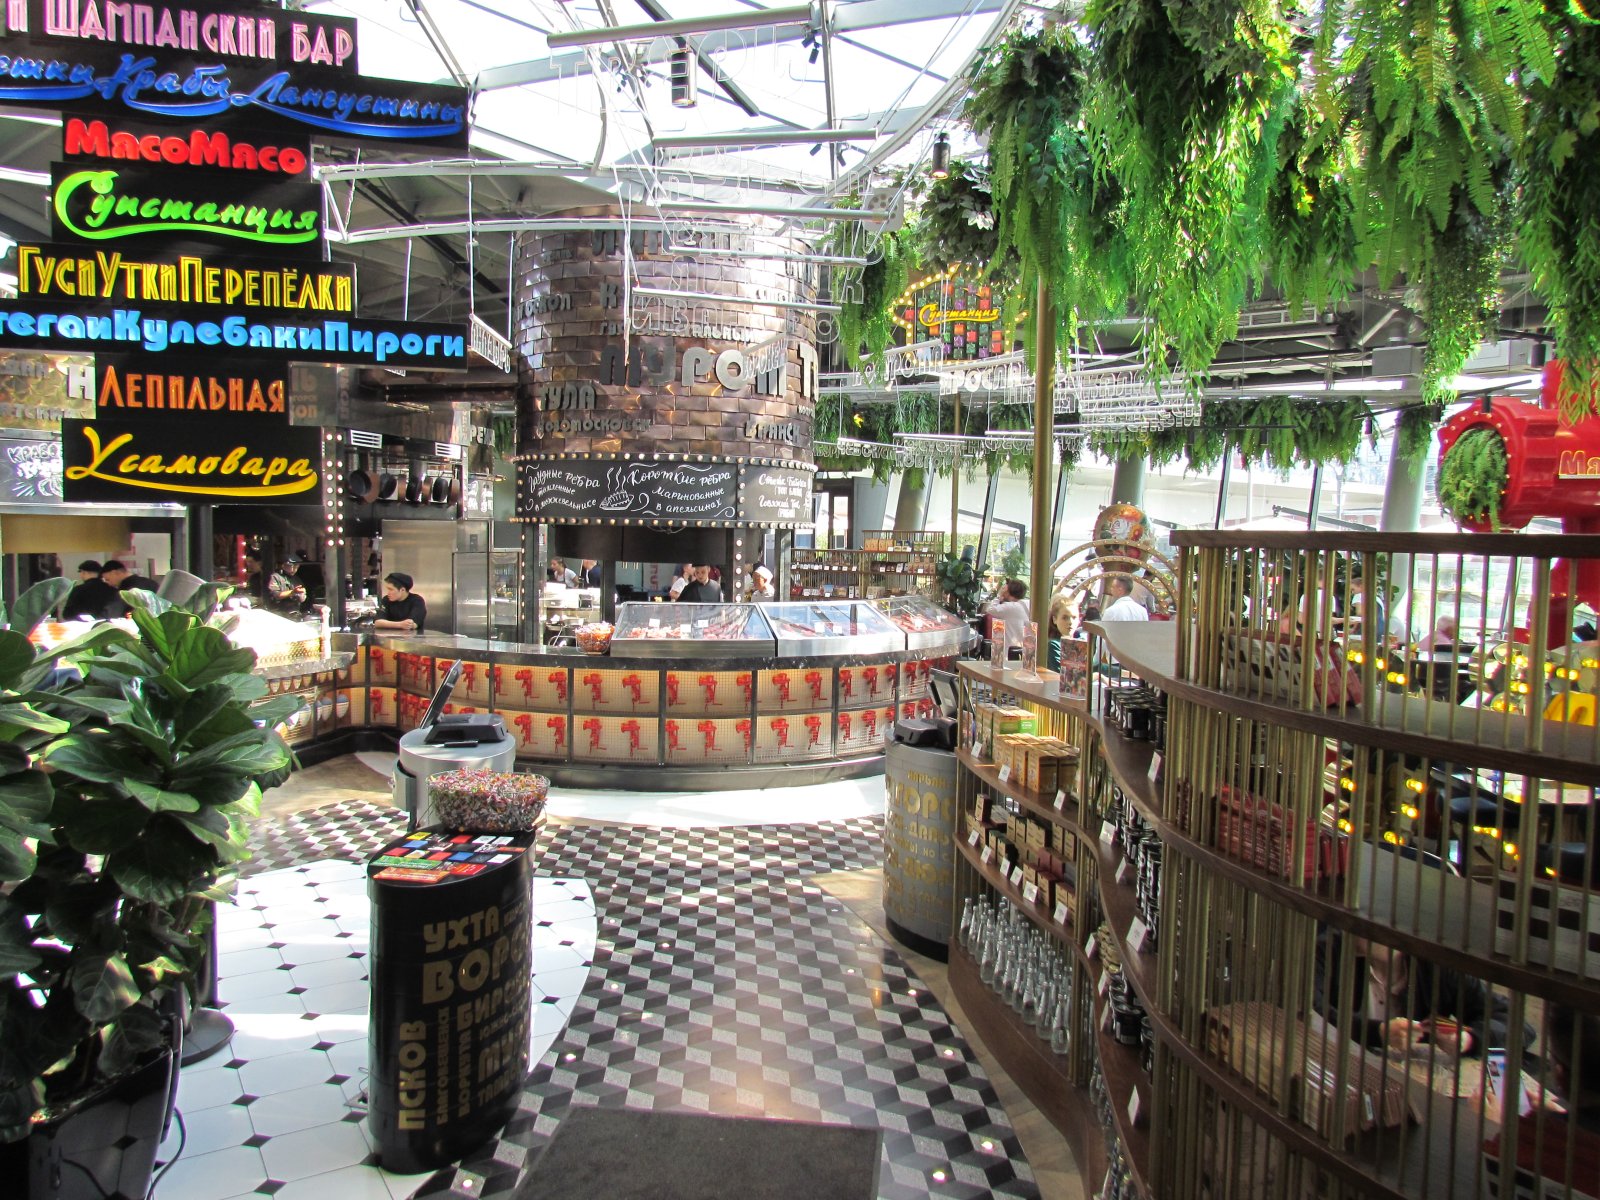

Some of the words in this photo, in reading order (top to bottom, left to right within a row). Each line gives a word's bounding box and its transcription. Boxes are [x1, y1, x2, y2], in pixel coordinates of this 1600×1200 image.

[292, 22, 354, 66] БАР
[423, 906, 499, 954] УХТА
[398, 1019, 427, 1130] ПСКОВ
